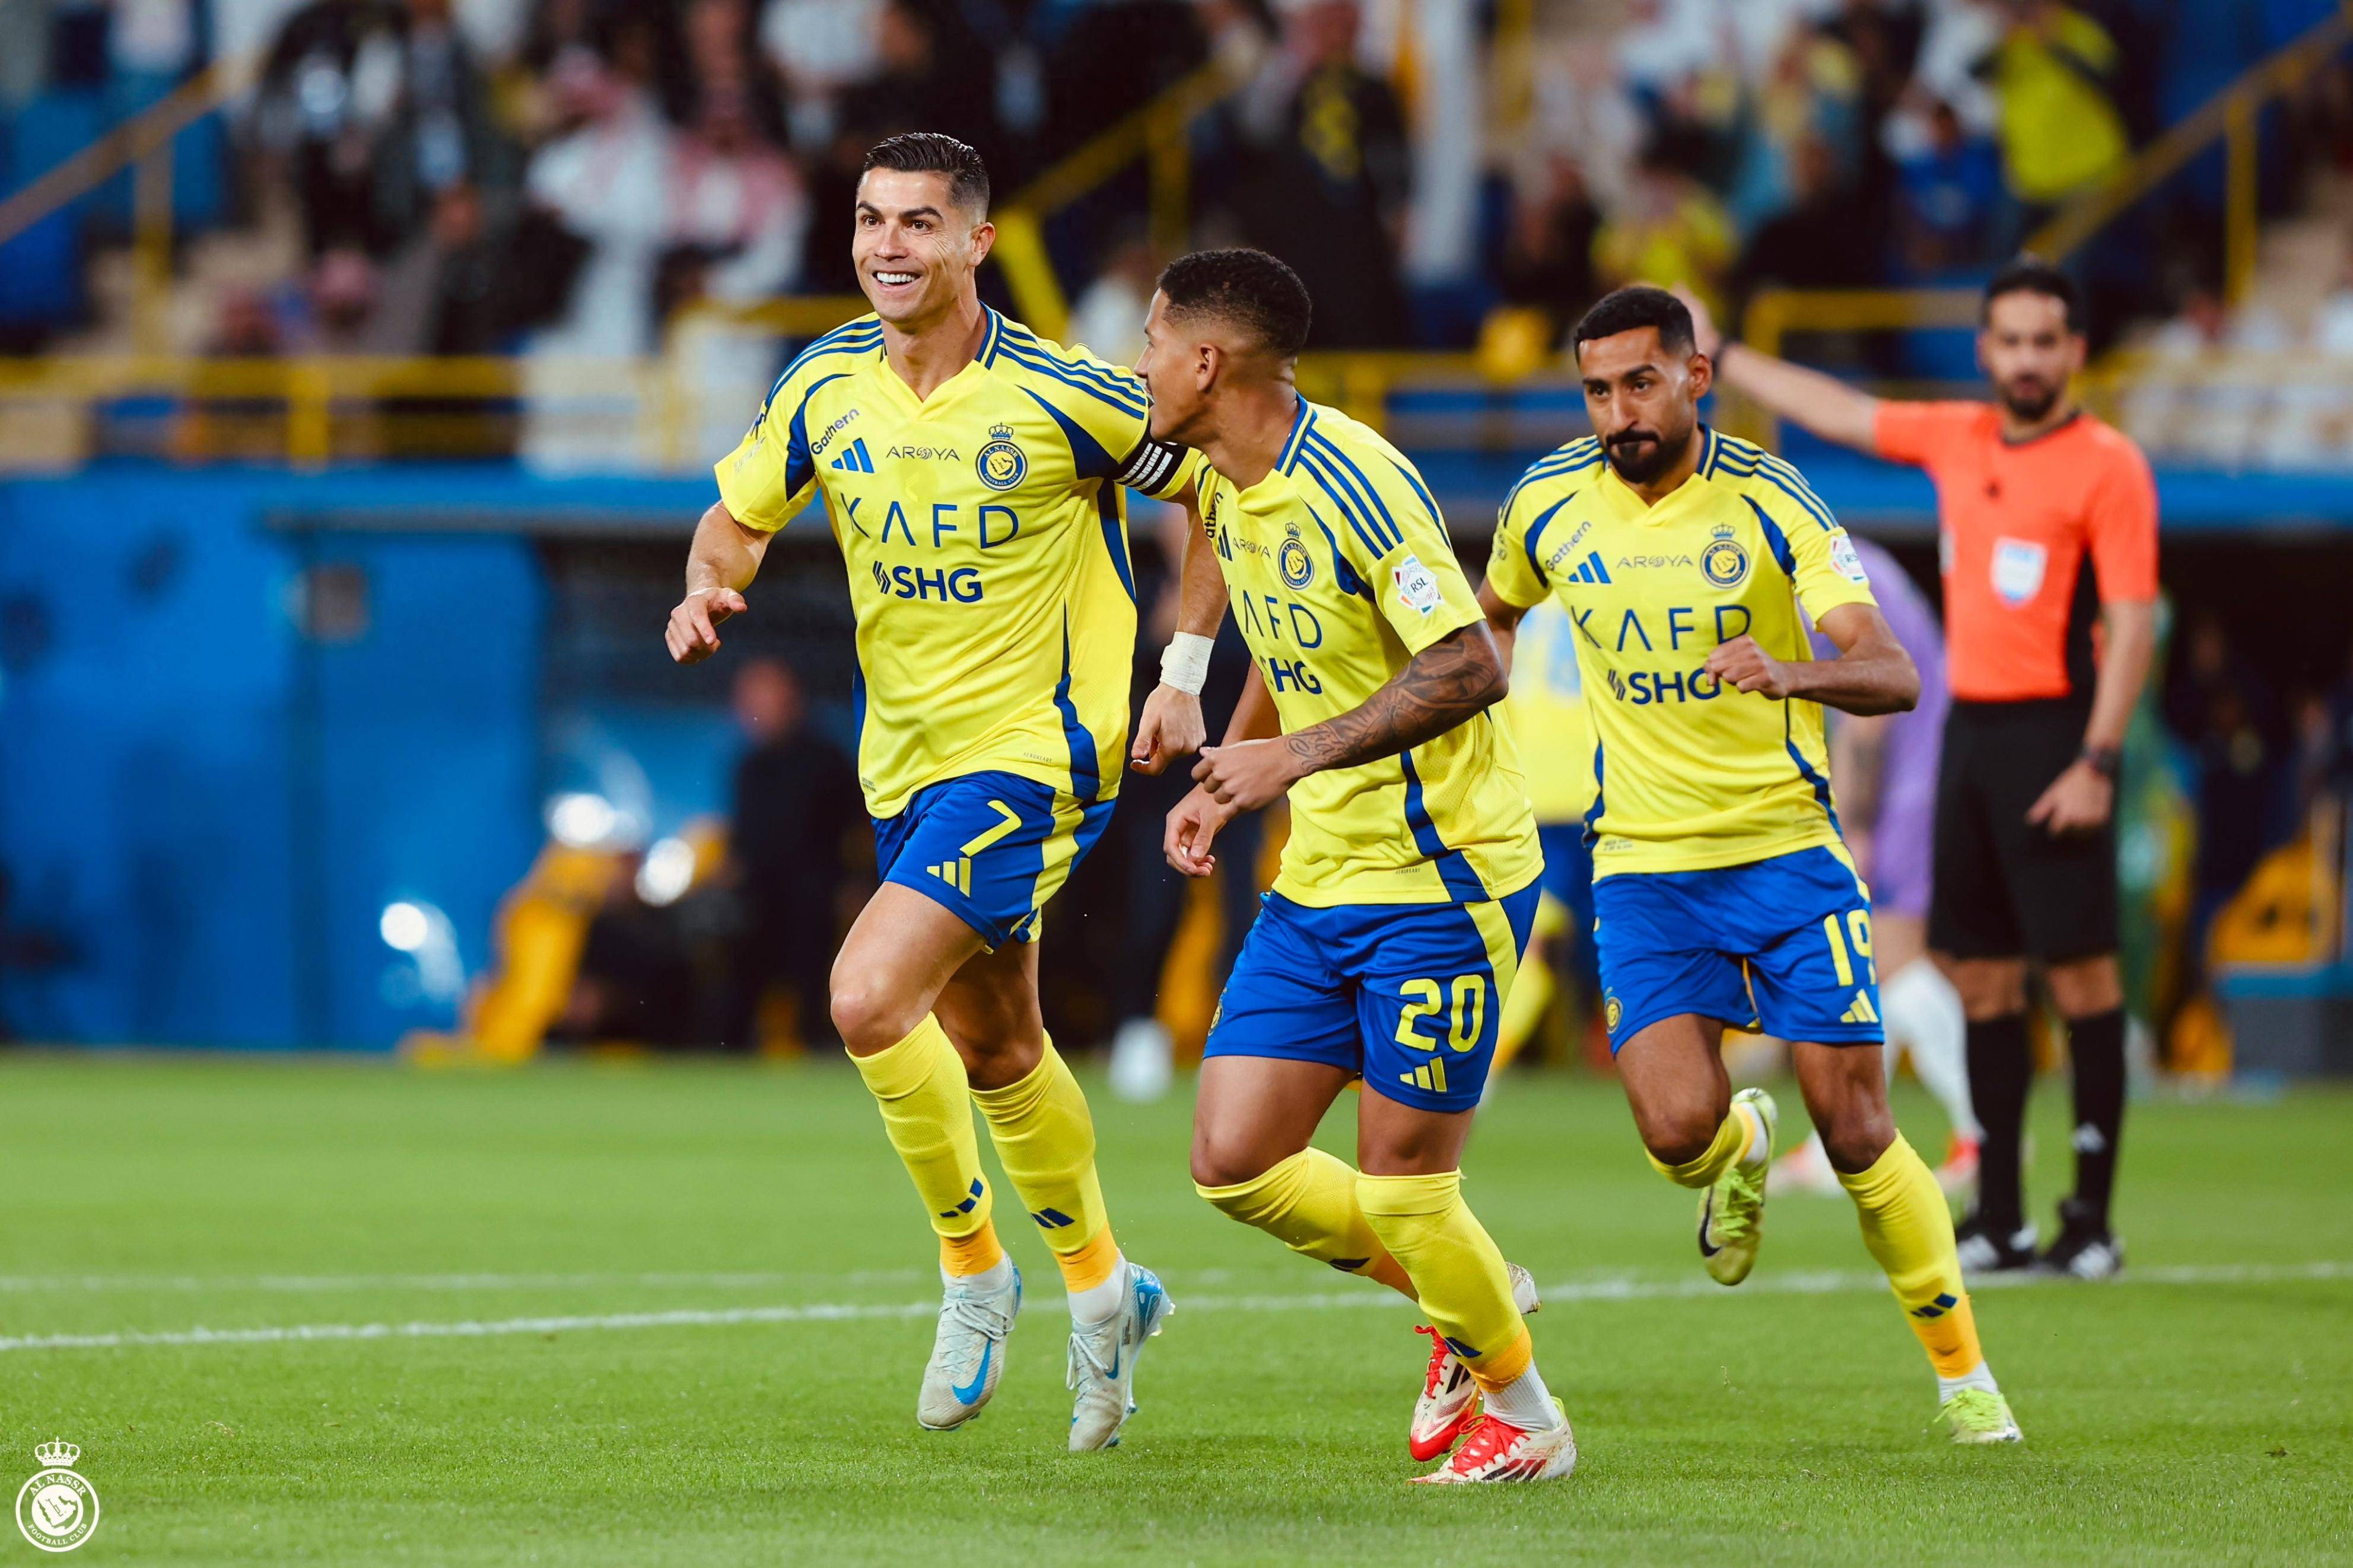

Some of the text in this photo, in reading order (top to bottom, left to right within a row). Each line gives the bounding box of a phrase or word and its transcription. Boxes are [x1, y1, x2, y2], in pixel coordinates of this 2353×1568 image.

[811, 408, 860, 455] Gathern
[886, 446, 961, 462] AROYA
[984, 446, 1018, 458] AL NASSR
[840, 492, 1019, 549] KAFD
[1204, 492, 1223, 539] athen
[1545, 521, 1592, 571] Gathern
[1616, 555, 1694, 569] AROYA
[1845, 553, 1858, 563] RS
[892, 565, 983, 603] SHG
[1410, 577, 1429, 593] RSL
[1229, 584, 1322, 648] AFD
[1571, 604, 1752, 651] KAFD
[1264, 656, 1322, 695] HG
[1629, 666, 1721, 705] SHG
[959, 800, 1023, 858] 7
[1823, 909, 1877, 987] 19
[1394, 974, 1486, 1053] 20
